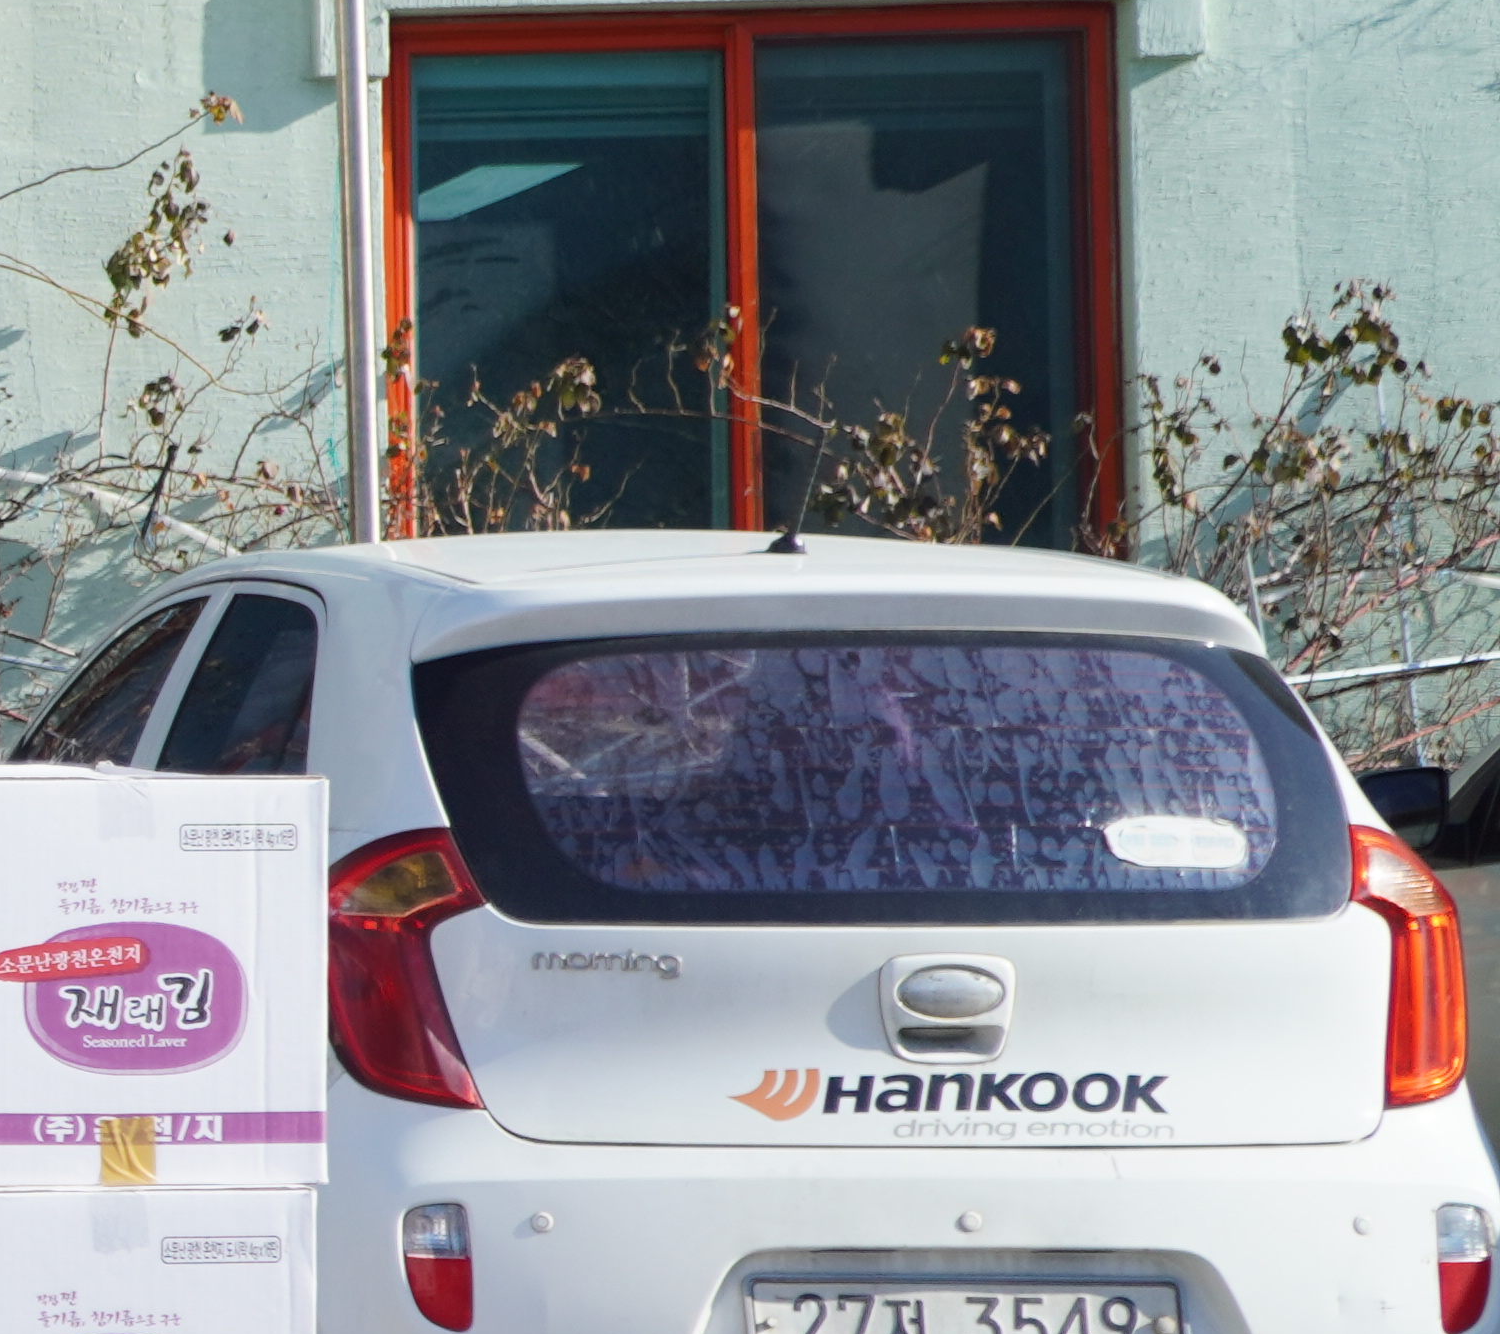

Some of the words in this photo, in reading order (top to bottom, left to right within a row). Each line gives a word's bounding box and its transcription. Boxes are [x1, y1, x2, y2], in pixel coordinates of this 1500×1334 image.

[532, 949, 682, 980] morning
[59, 968, 213, 1030] 재래김
[83, 1035, 145, 1048] Seasoned
[148, 1035, 187, 1048] Laver
[894, 1117, 1017, 1141] driving
[1027, 1116, 1174, 1140] emotion
